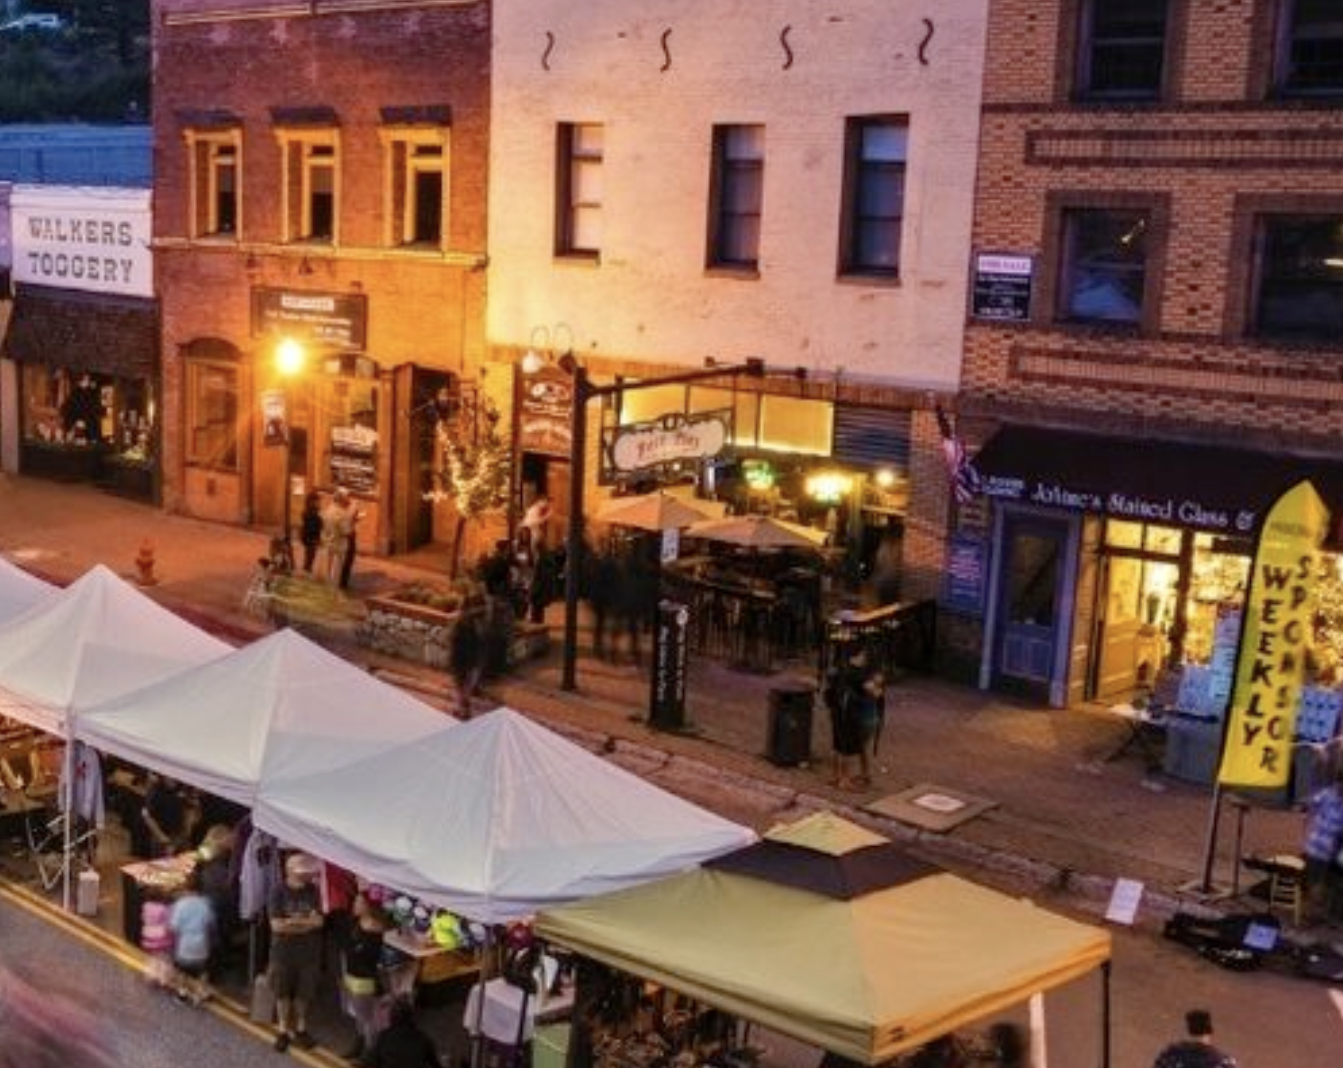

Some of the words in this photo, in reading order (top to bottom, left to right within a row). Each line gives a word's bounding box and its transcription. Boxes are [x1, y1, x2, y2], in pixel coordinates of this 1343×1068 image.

[28, 216, 132, 247] WALKERS
[28, 250, 132, 283] TOGGERY
[1108, 493, 1172, 519] Stained
[1178, 500, 1228, 527] Glass
[1242, 564, 1291, 746] WEEKLY
[1260, 556, 1311, 773] SPONSOR
